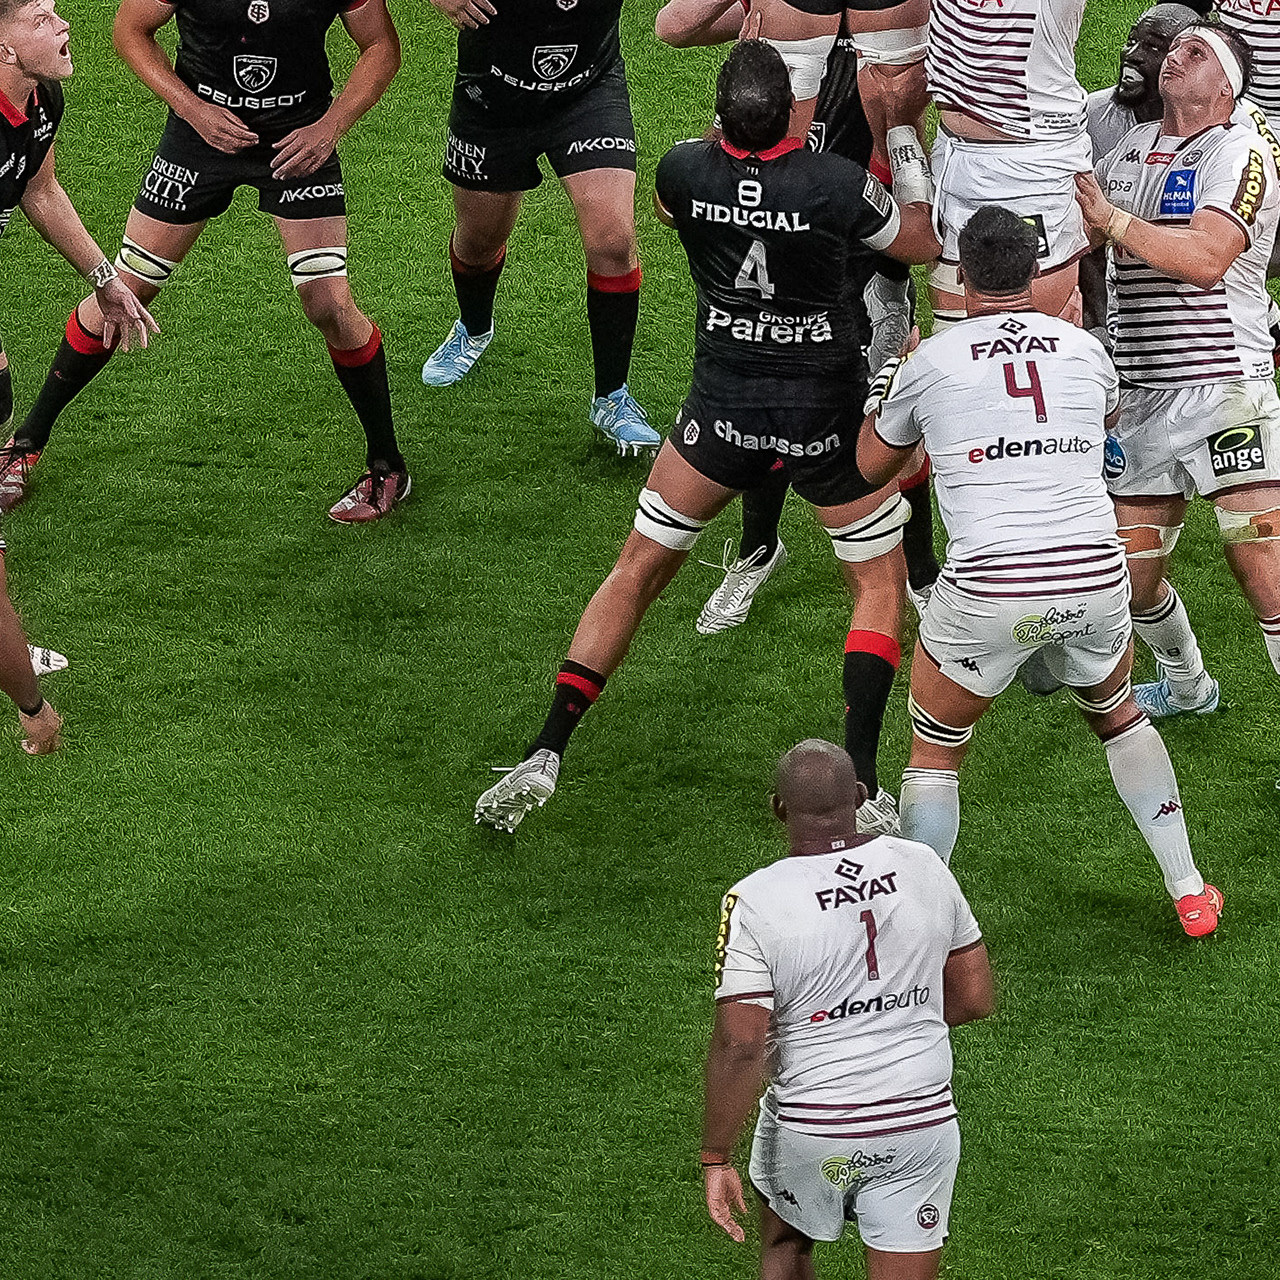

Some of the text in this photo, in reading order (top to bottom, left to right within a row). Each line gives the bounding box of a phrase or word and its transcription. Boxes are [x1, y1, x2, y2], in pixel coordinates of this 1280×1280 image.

[197, 82, 307, 110] PEUGEOT
[566, 138, 637, 156] AKKODIS
[145, 169, 193, 203] CITY
[152, 154, 200, 186] GREEN
[278, 183, 345, 204] AKKODIS
[691, 199, 811, 233] FIDUCIAL
[734, 239, 776, 300] 4
[705, 305, 834, 345] Parera
[970, 335, 1061, 361] FAYAT
[1002, 360, 1048, 423] 4
[712, 419, 841, 457] chausson
[967, 434, 1093, 464] edenauto
[1212, 446, 1265, 470] ange
[815, 870, 900, 912] FAYAT
[859, 908, 880, 982] 1
[810, 984, 931, 1024] edenauto
